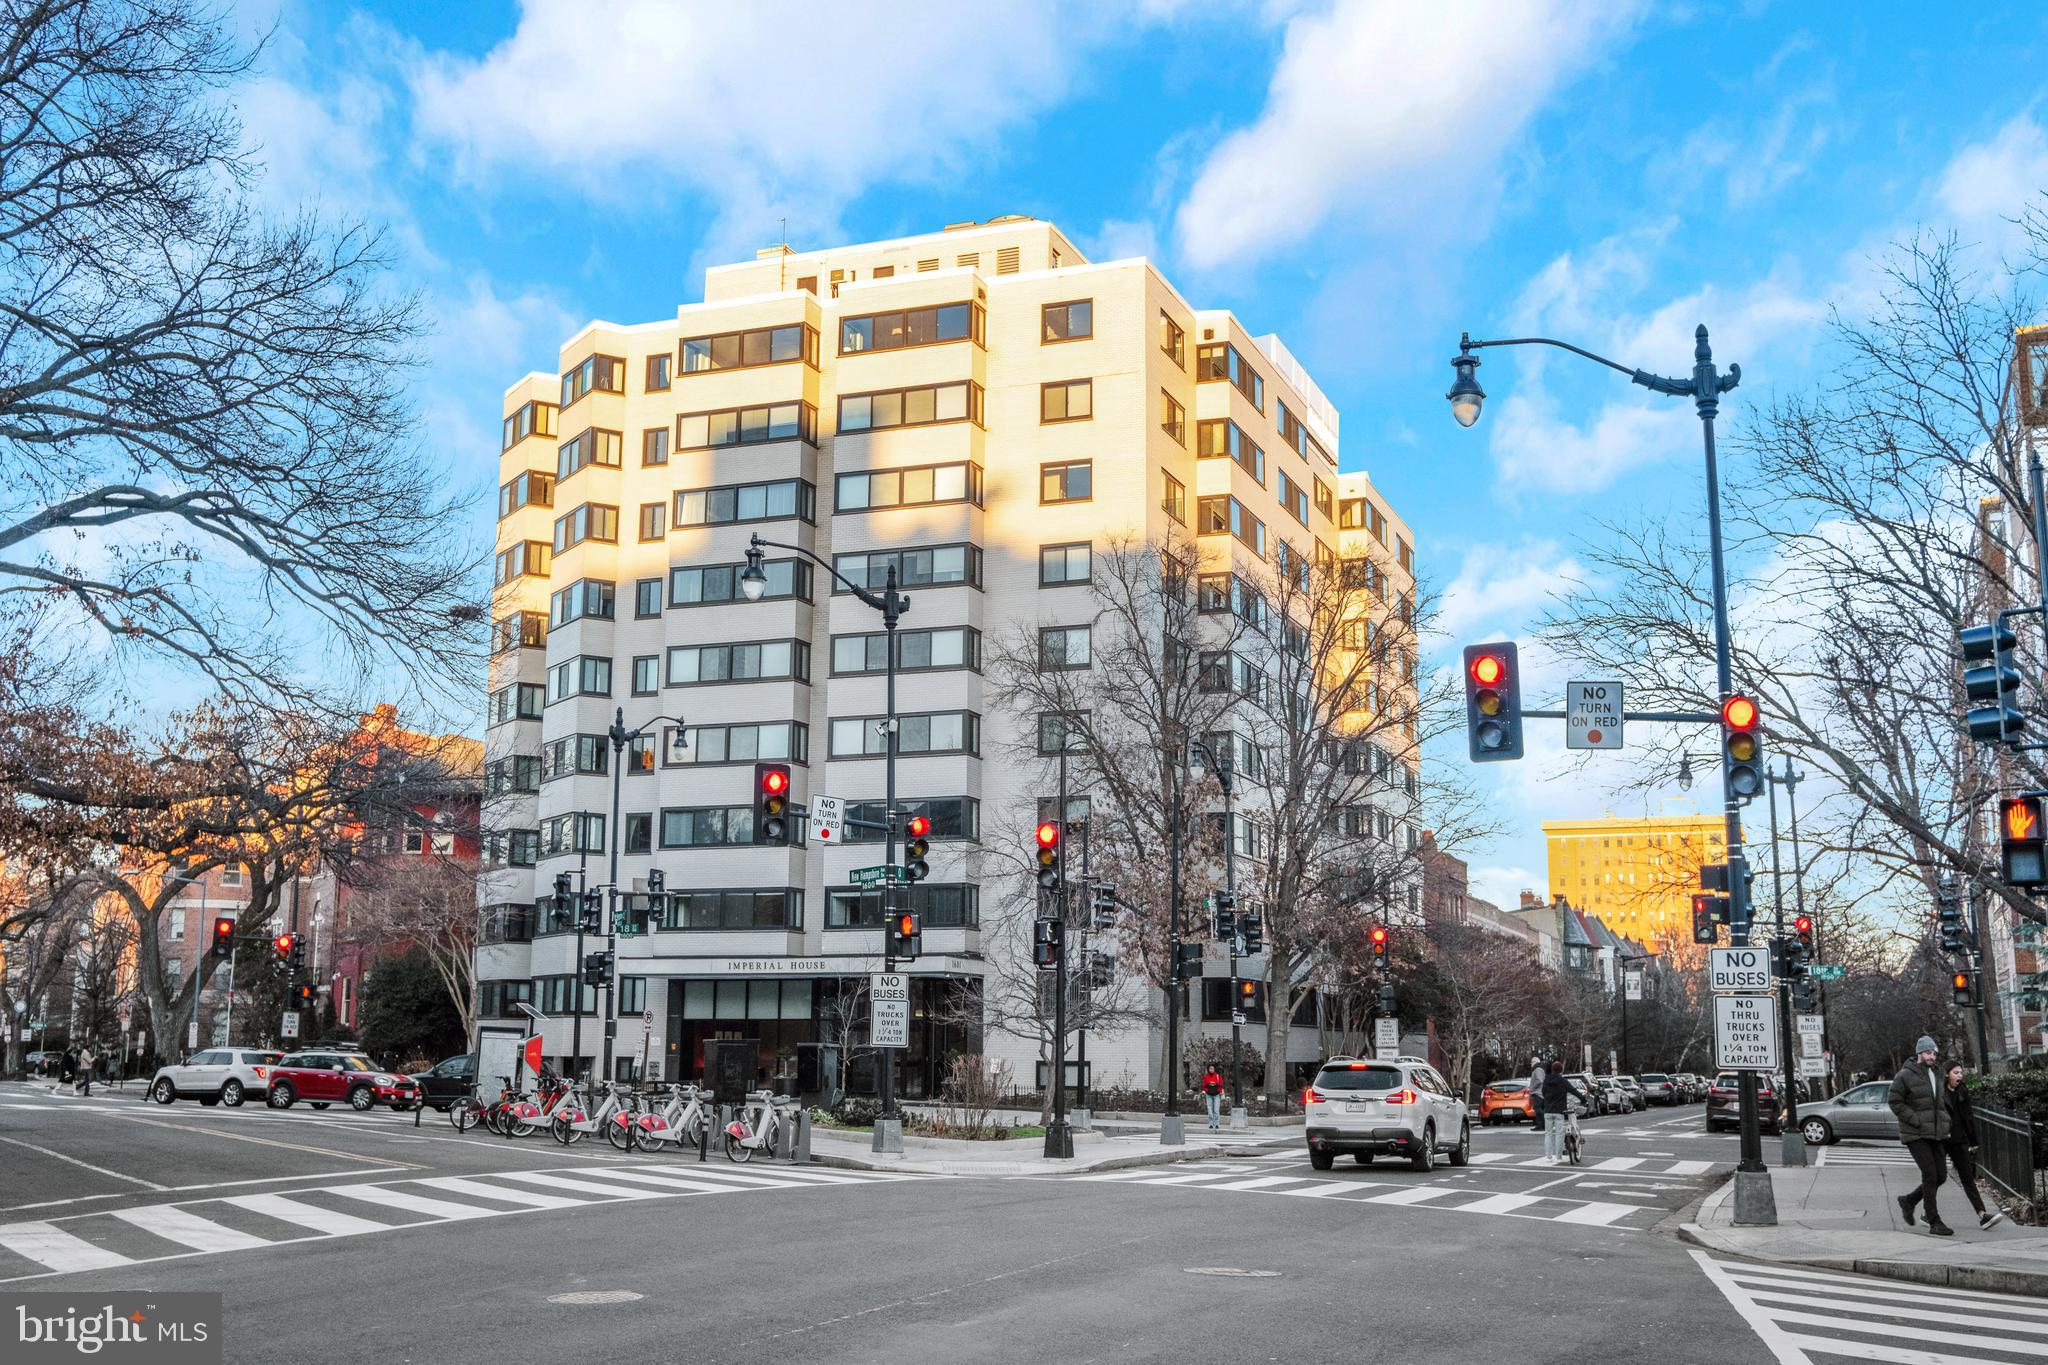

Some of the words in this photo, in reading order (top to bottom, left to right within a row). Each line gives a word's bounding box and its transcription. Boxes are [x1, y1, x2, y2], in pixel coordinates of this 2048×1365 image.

[1584, 687, 1606, 699] NO
[1580, 703, 1610, 713] TURN
[1572, 717, 1587, 727] ON
[1595, 717, 1618, 727] RED
[822, 800, 835, 809] NO
[819, 810, 836, 818] TURN
[851, 871, 859, 881] New
[860, 870, 880, 880] Hampshire
[862, 881, 876, 890] 1600
[1726, 952, 1756, 967] NO
[790, 962, 825, 970] HOUSE
[881, 976, 899, 986] NO
[1716, 972, 1766, 985] BUSES
[874, 990, 904, 998] BUSES
[1736, 1000, 1752, 1008] NO
[1731, 1011, 1759, 1020] THRU
[1726, 1022, 1764, 1032] TRUCKS
[1732, 1034, 1759, 1042] OVER
[1724, 1054, 1768, 1064] CAPACITY
